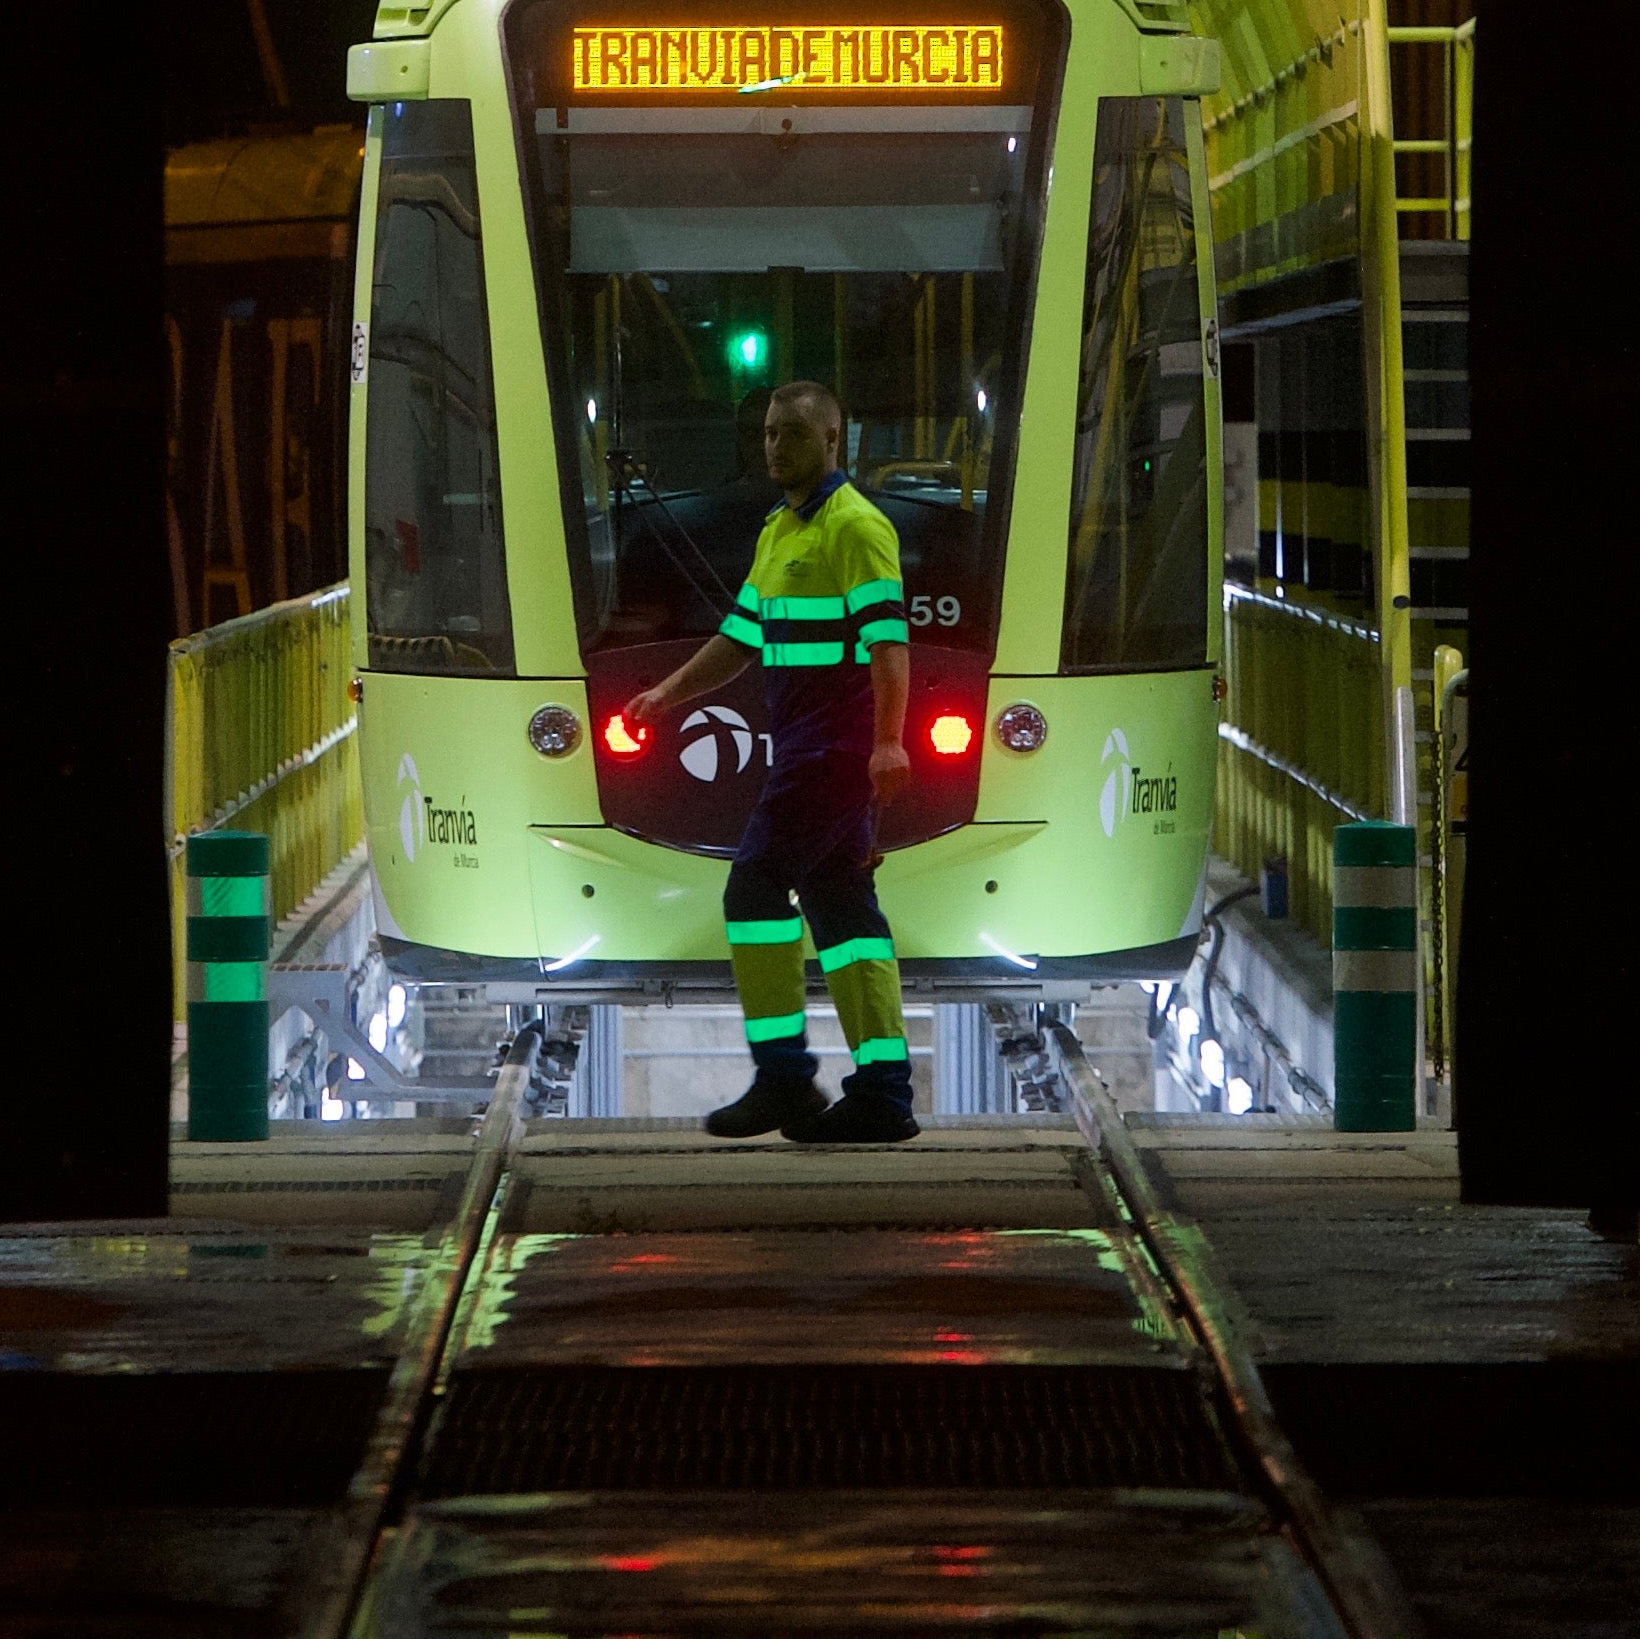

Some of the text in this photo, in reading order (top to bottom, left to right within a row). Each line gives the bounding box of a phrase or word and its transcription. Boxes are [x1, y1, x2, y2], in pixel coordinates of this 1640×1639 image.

[909, 595, 961, 627] 59
[1131, 761, 1177, 814] Tranvía
[424, 794, 477, 845] Tranvía
